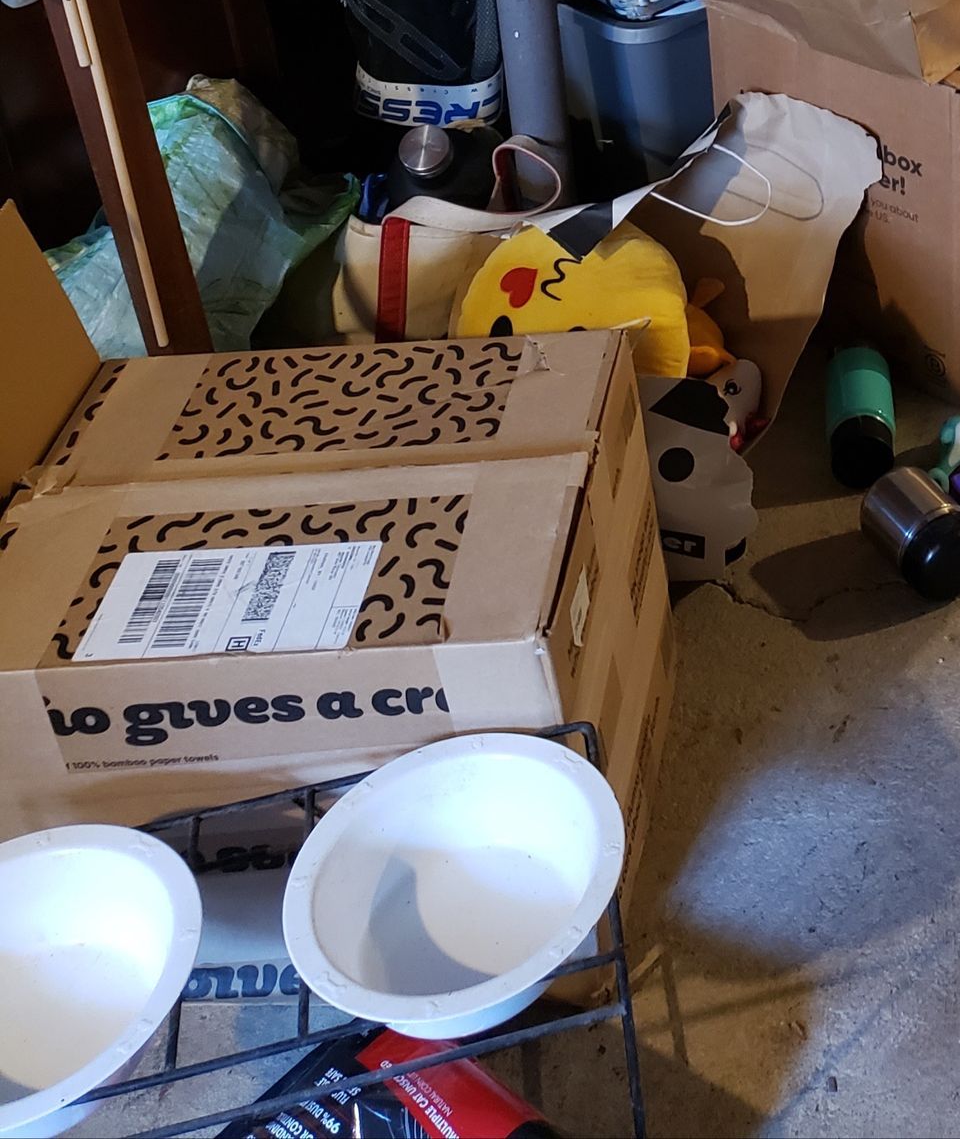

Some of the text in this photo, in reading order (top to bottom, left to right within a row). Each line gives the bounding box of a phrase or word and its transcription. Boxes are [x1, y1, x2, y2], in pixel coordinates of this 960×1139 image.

[888, 204, 919, 223] about
[123, 693, 306, 746] gives
[316, 690, 364, 720] a
[72, 761, 100, 770] 100%
[102, 758, 147, 768] bamboo
[150, 757, 181, 767] paper
[183, 753, 220, 764] towels
[415, 1077, 432, 1094] CORN
[412, 1092, 429, 1109] CAT
[429, 1090, 453, 1117] NATURAL
[320, 1112, 341, 1134] 99%
